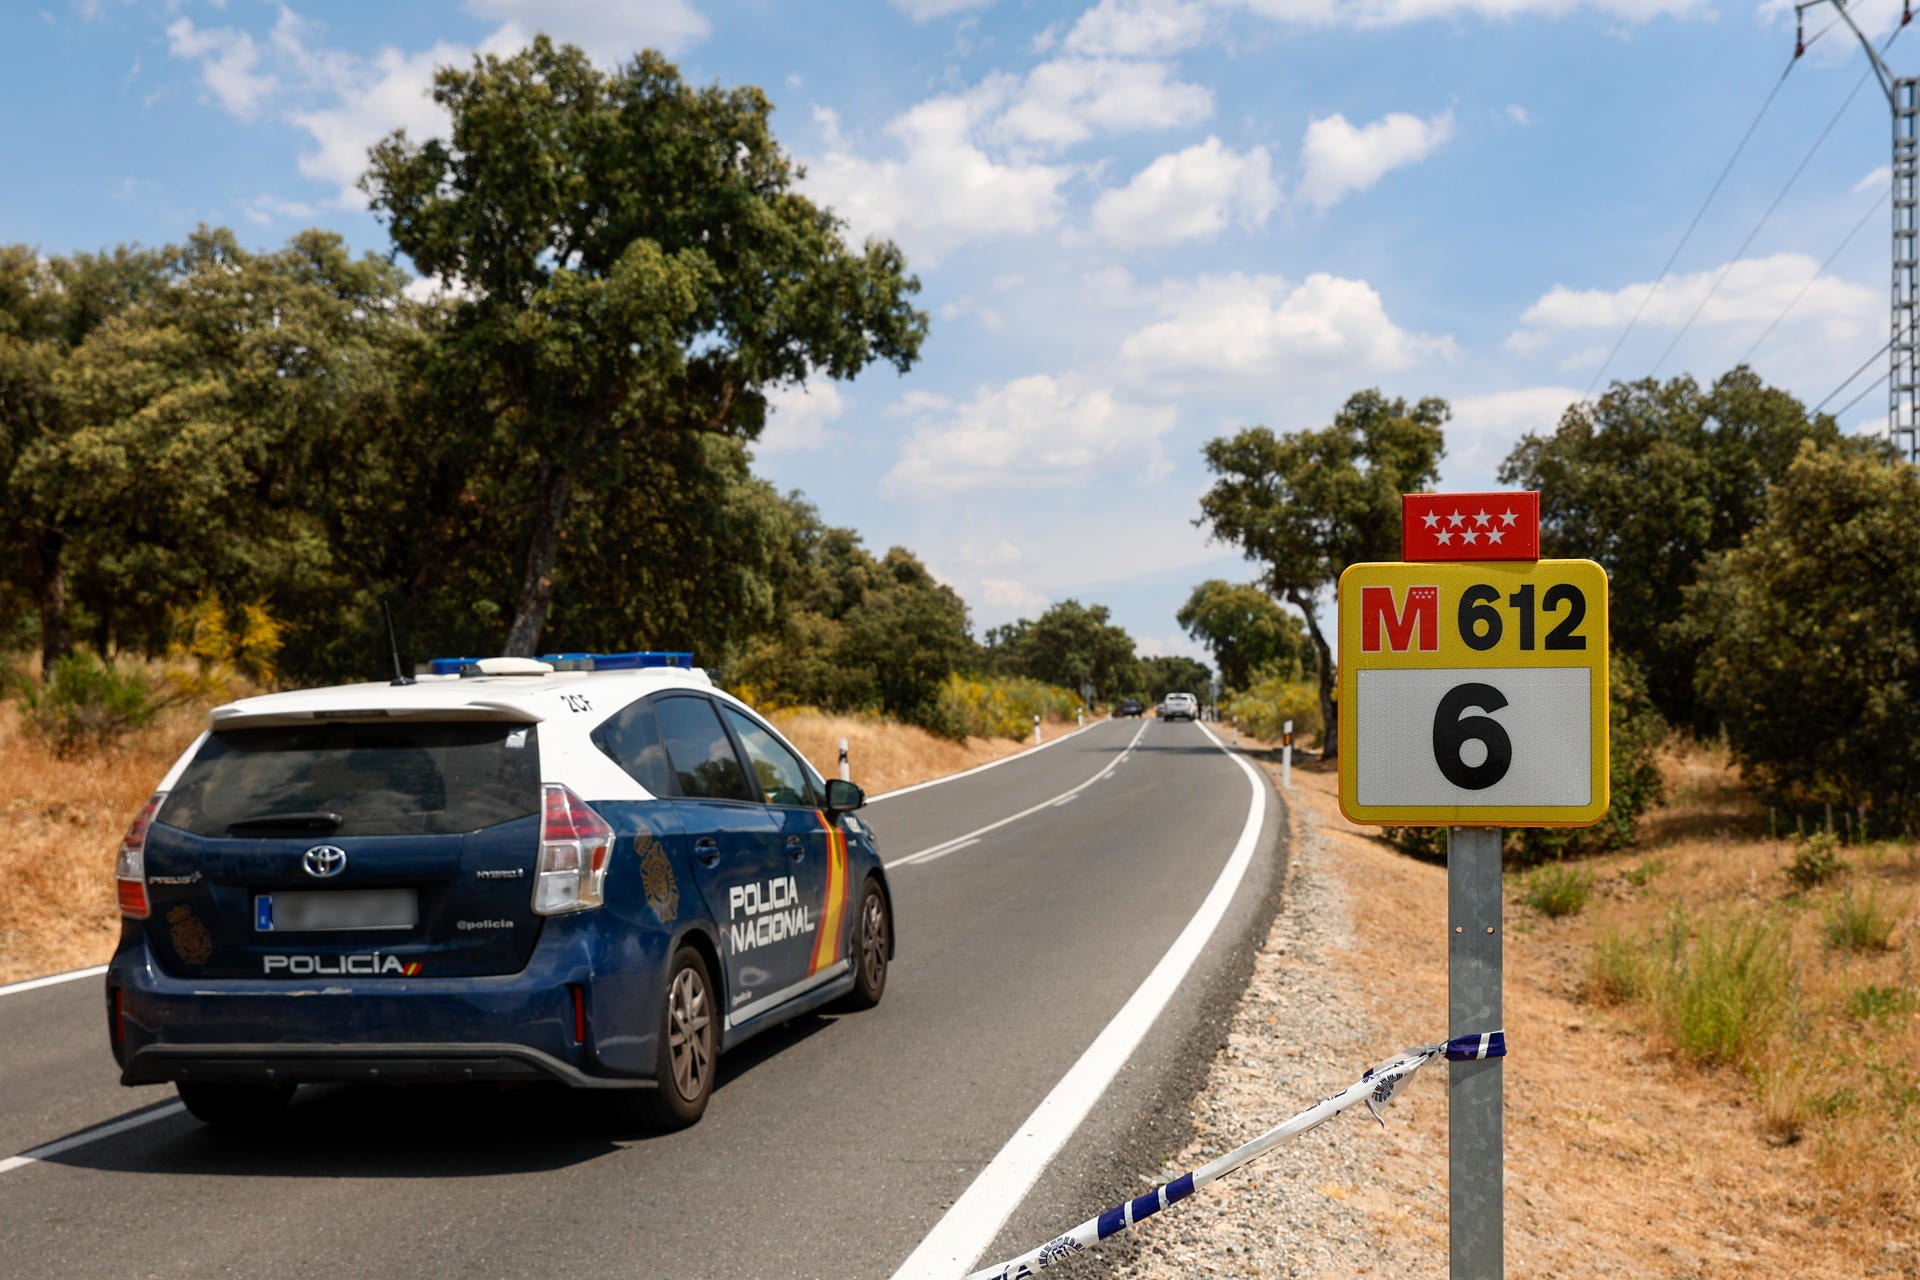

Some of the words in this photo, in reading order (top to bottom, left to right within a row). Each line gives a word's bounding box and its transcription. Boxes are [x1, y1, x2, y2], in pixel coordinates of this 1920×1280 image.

[1361, 585, 1439, 653] M
[1458, 583, 1587, 651] 612
[1433, 682, 1512, 790] 6
[730, 905, 815, 955] NACIONAL
[263, 951, 404, 974] POLICÍA
